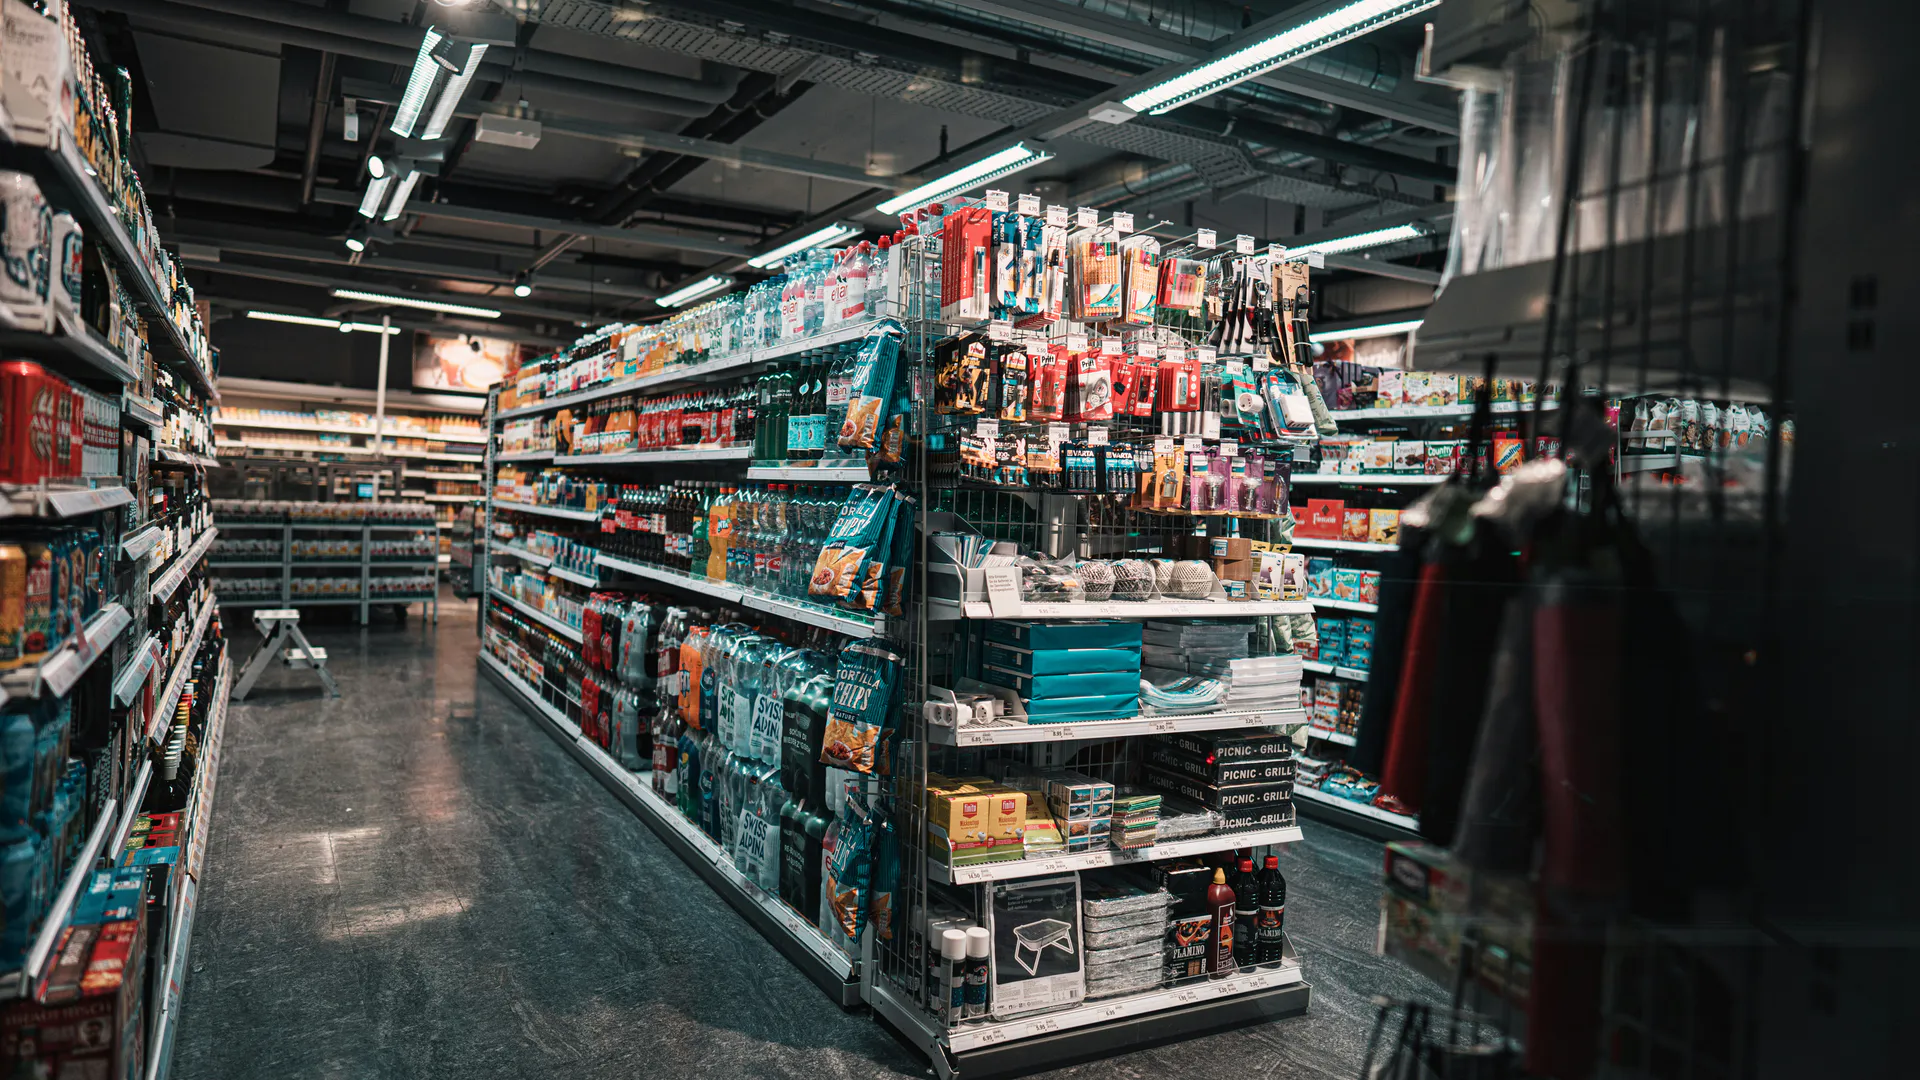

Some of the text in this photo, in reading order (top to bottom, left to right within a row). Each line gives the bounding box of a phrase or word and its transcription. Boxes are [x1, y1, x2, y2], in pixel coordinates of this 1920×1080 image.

[1041, 355, 1055, 364] Pritt
[1081, 360, 1095, 369] Pritt
[1427, 445, 1453, 457] Country
[1335, 574, 1358, 582] Country
[836, 669, 881, 690] TORTILLA
[834, 681, 873, 711] CHIPS
[835, 711, 856, 722] NATURE
[1179, 738, 1202, 754] GRILL
[1217, 746, 1252, 758] PICNIC
[1260, 743, 1289, 755] GRILL
[1152, 751, 1178, 767] PICNIC
[1184, 761, 1208, 777] GRILL
[1223, 769, 1257, 781] PICNIC
[1264, 766, 1293, 778] GRILL
[1148, 773, 1175, 790] PICNIC
[1180, 785, 1205, 801] GRILL
[1222, 794, 1255, 806] PICNIC
[1262, 790, 1291, 801] GRILL
[743, 813, 768, 842] SWISS
[1219, 817, 1252, 830] PICNIC
[1260, 813, 1288, 824] GRILL
[739, 831, 765, 861] ALPINA
[1172, 945, 1206, 959] FLAMINO
